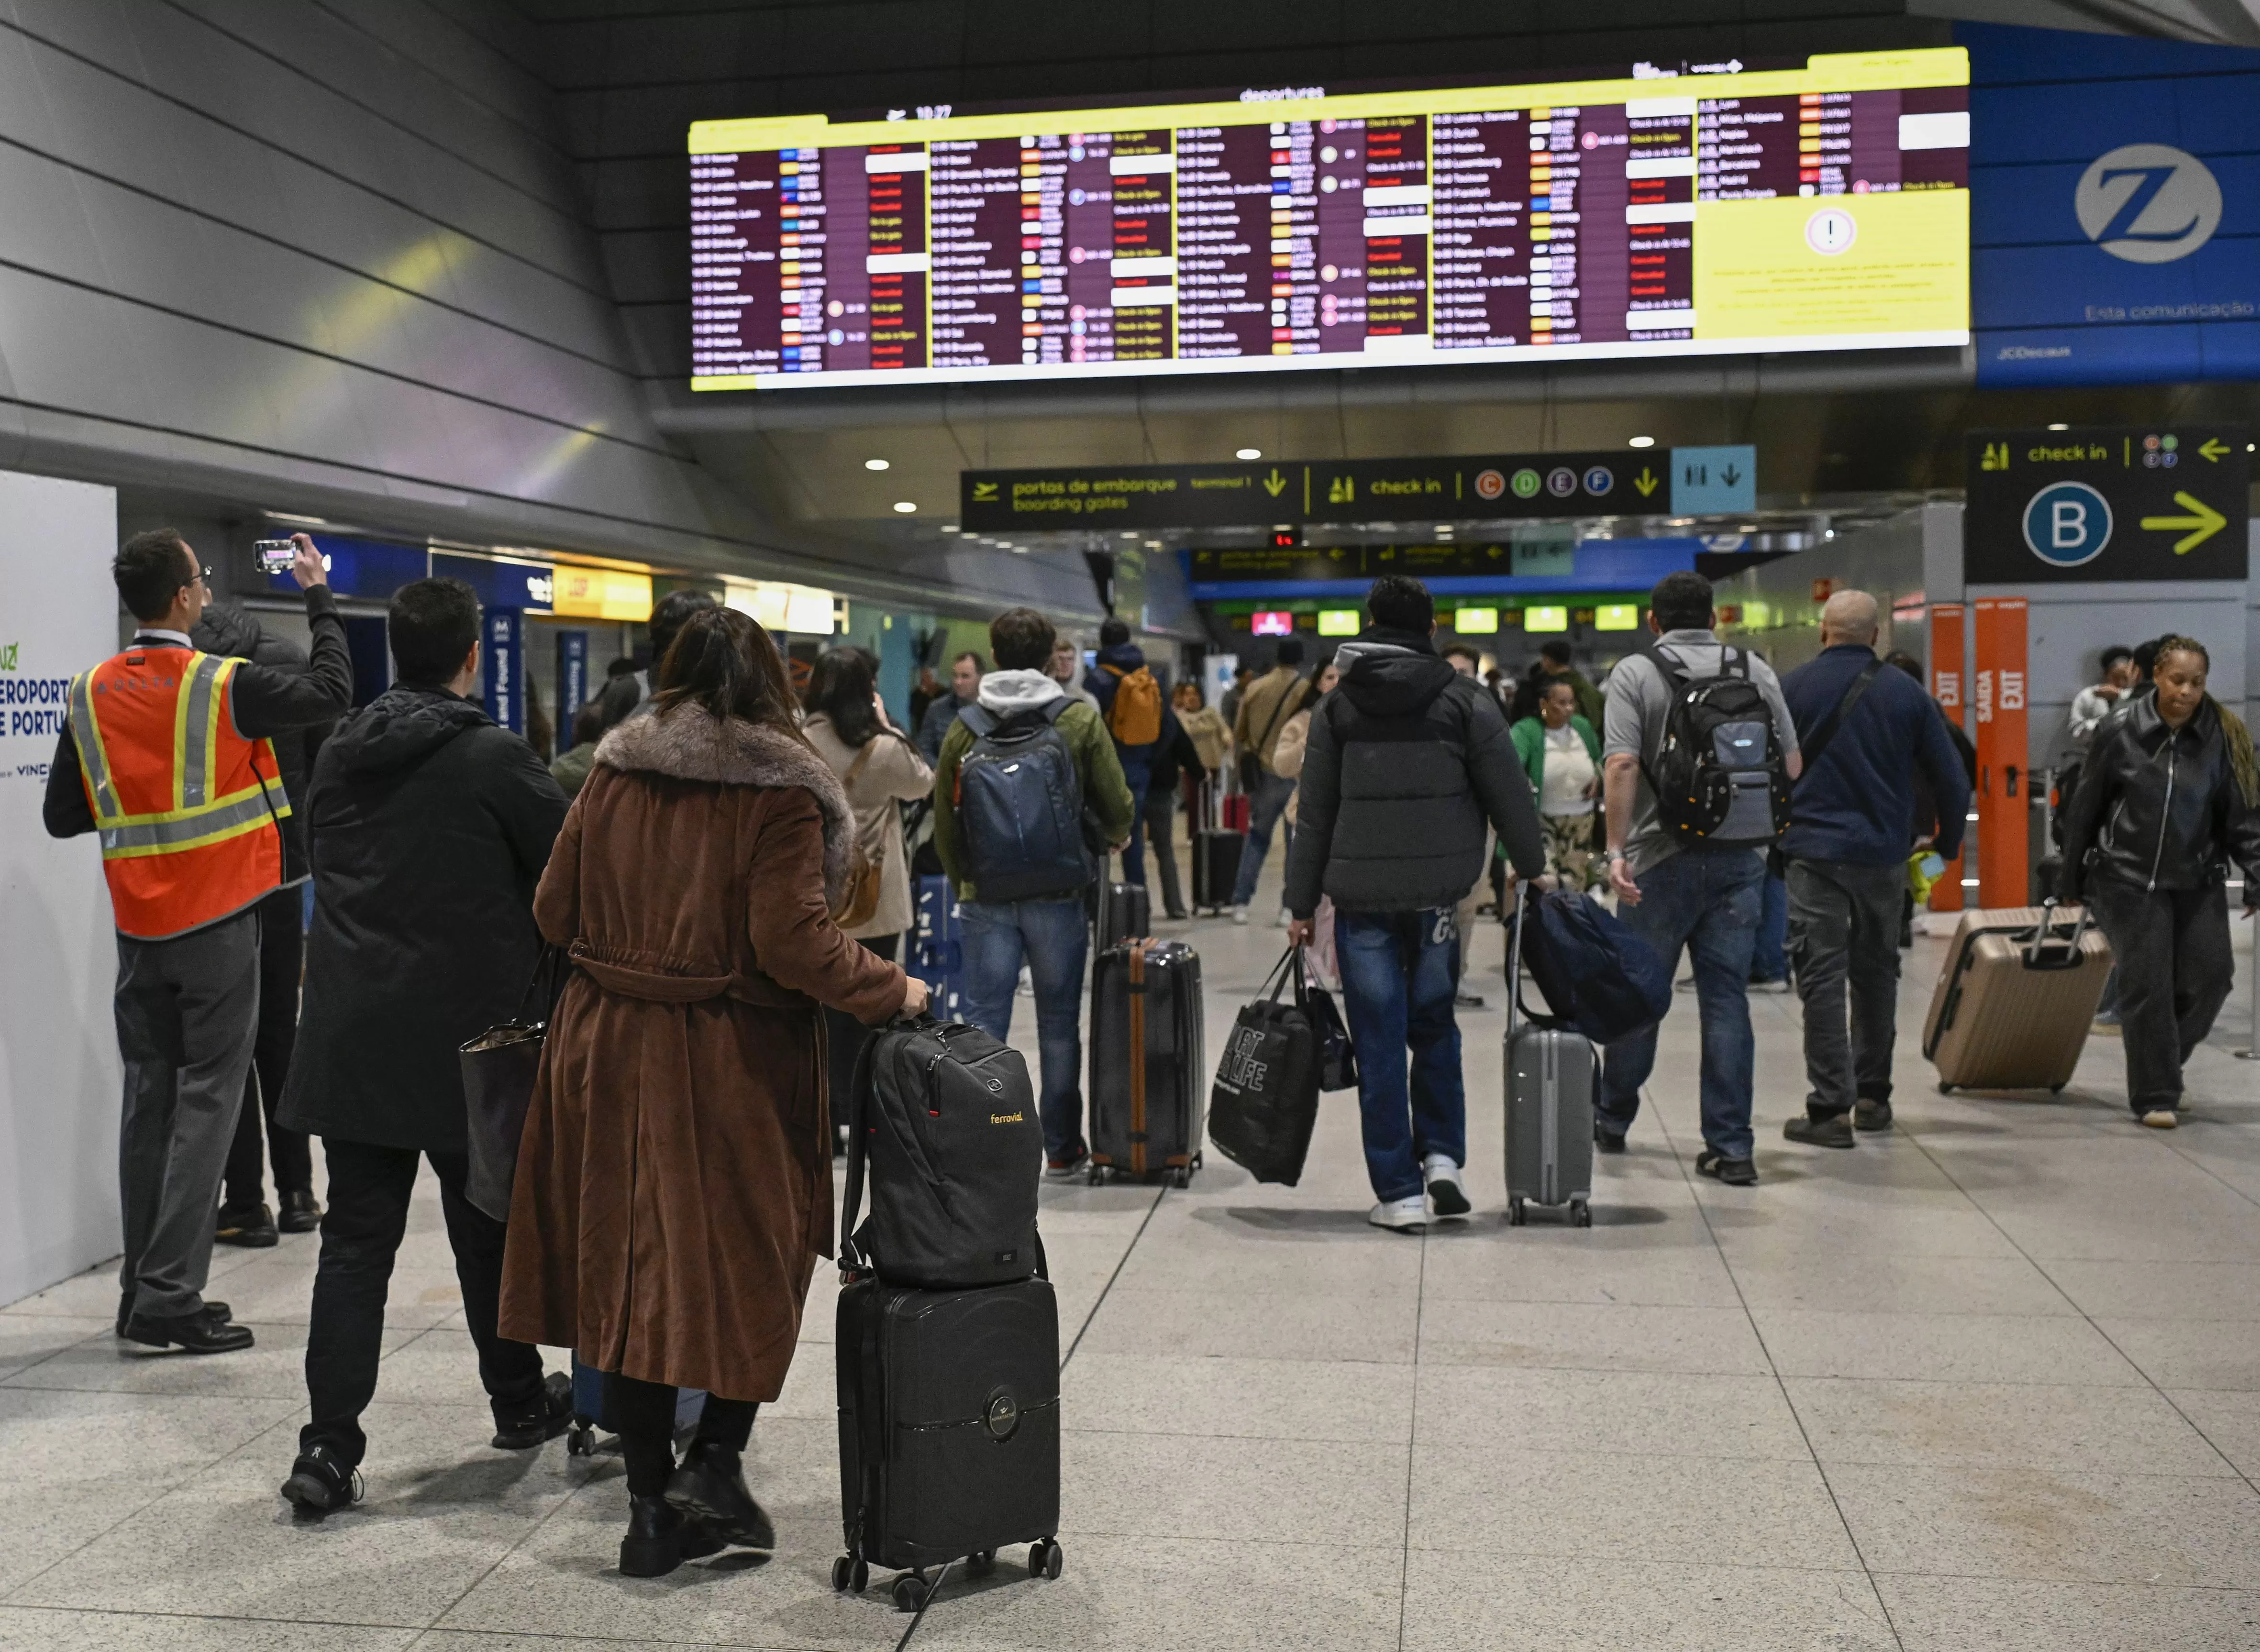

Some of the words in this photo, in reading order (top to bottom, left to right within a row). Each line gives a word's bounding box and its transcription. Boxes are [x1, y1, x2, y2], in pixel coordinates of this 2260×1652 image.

[2129, 301, 2254, 319] comunicação
[2028, 444, 2085, 462] check
[2090, 442, 2107, 460] in
[1013, 481, 1065, 499] portas
[1068, 480, 1089, 494] de
[1092, 479, 1177, 494] embarque
[1370, 479, 1422, 495] check
[1425, 476, 1441, 493] in
[1013, 497, 1082, 513] boarding
[1085, 497, 1129, 512] gates
[2052, 501, 2088, 548] B
[114, 676, 175, 692] DELTA
[1999, 669, 2025, 710] EXIT
[990, 1110, 1023, 1124] ferrovial
